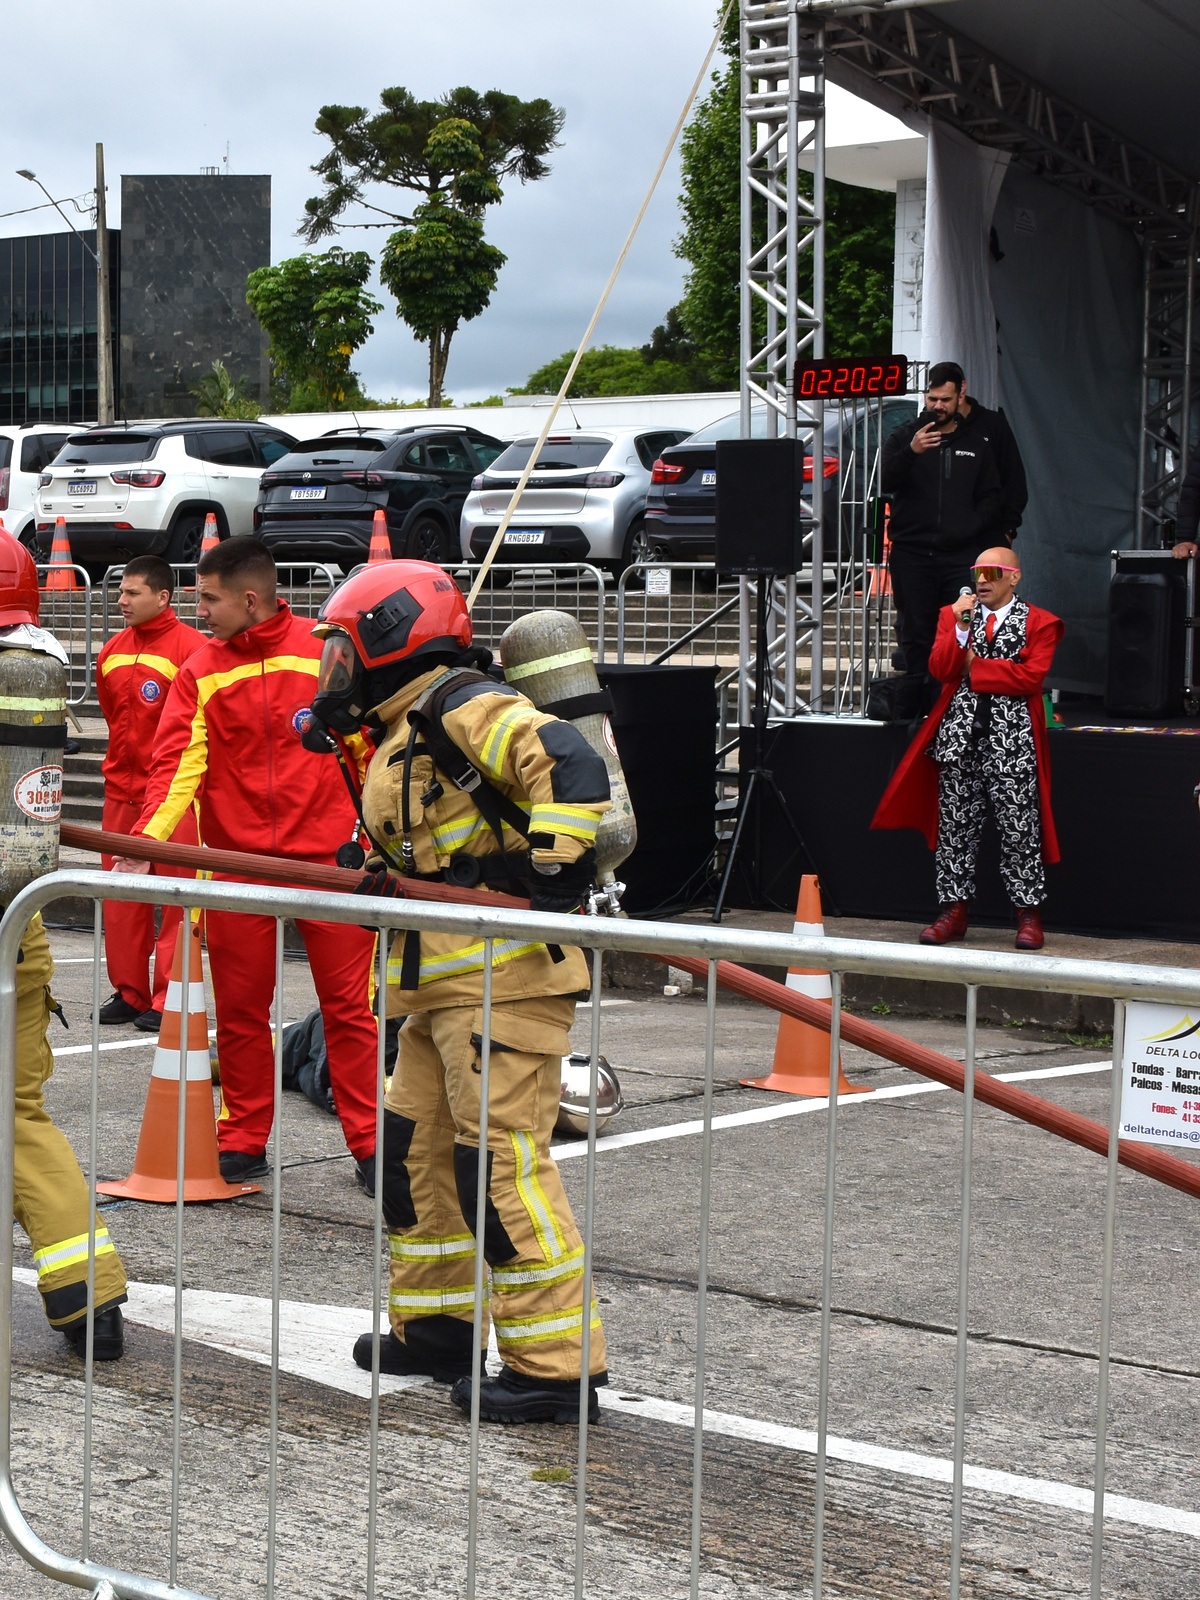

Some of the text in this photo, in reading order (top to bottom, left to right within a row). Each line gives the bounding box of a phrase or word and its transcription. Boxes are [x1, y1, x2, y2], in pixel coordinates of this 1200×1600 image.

[1146, 1046, 1200, 1060] DELTA LO
[1132, 1062, 1200, 1080] Tendas Barr
[1131, 1077, 1162, 1090] Palcos
[1152, 1102, 1178, 1115] Fones:
[1182, 1113, 1191, 1122] 41
